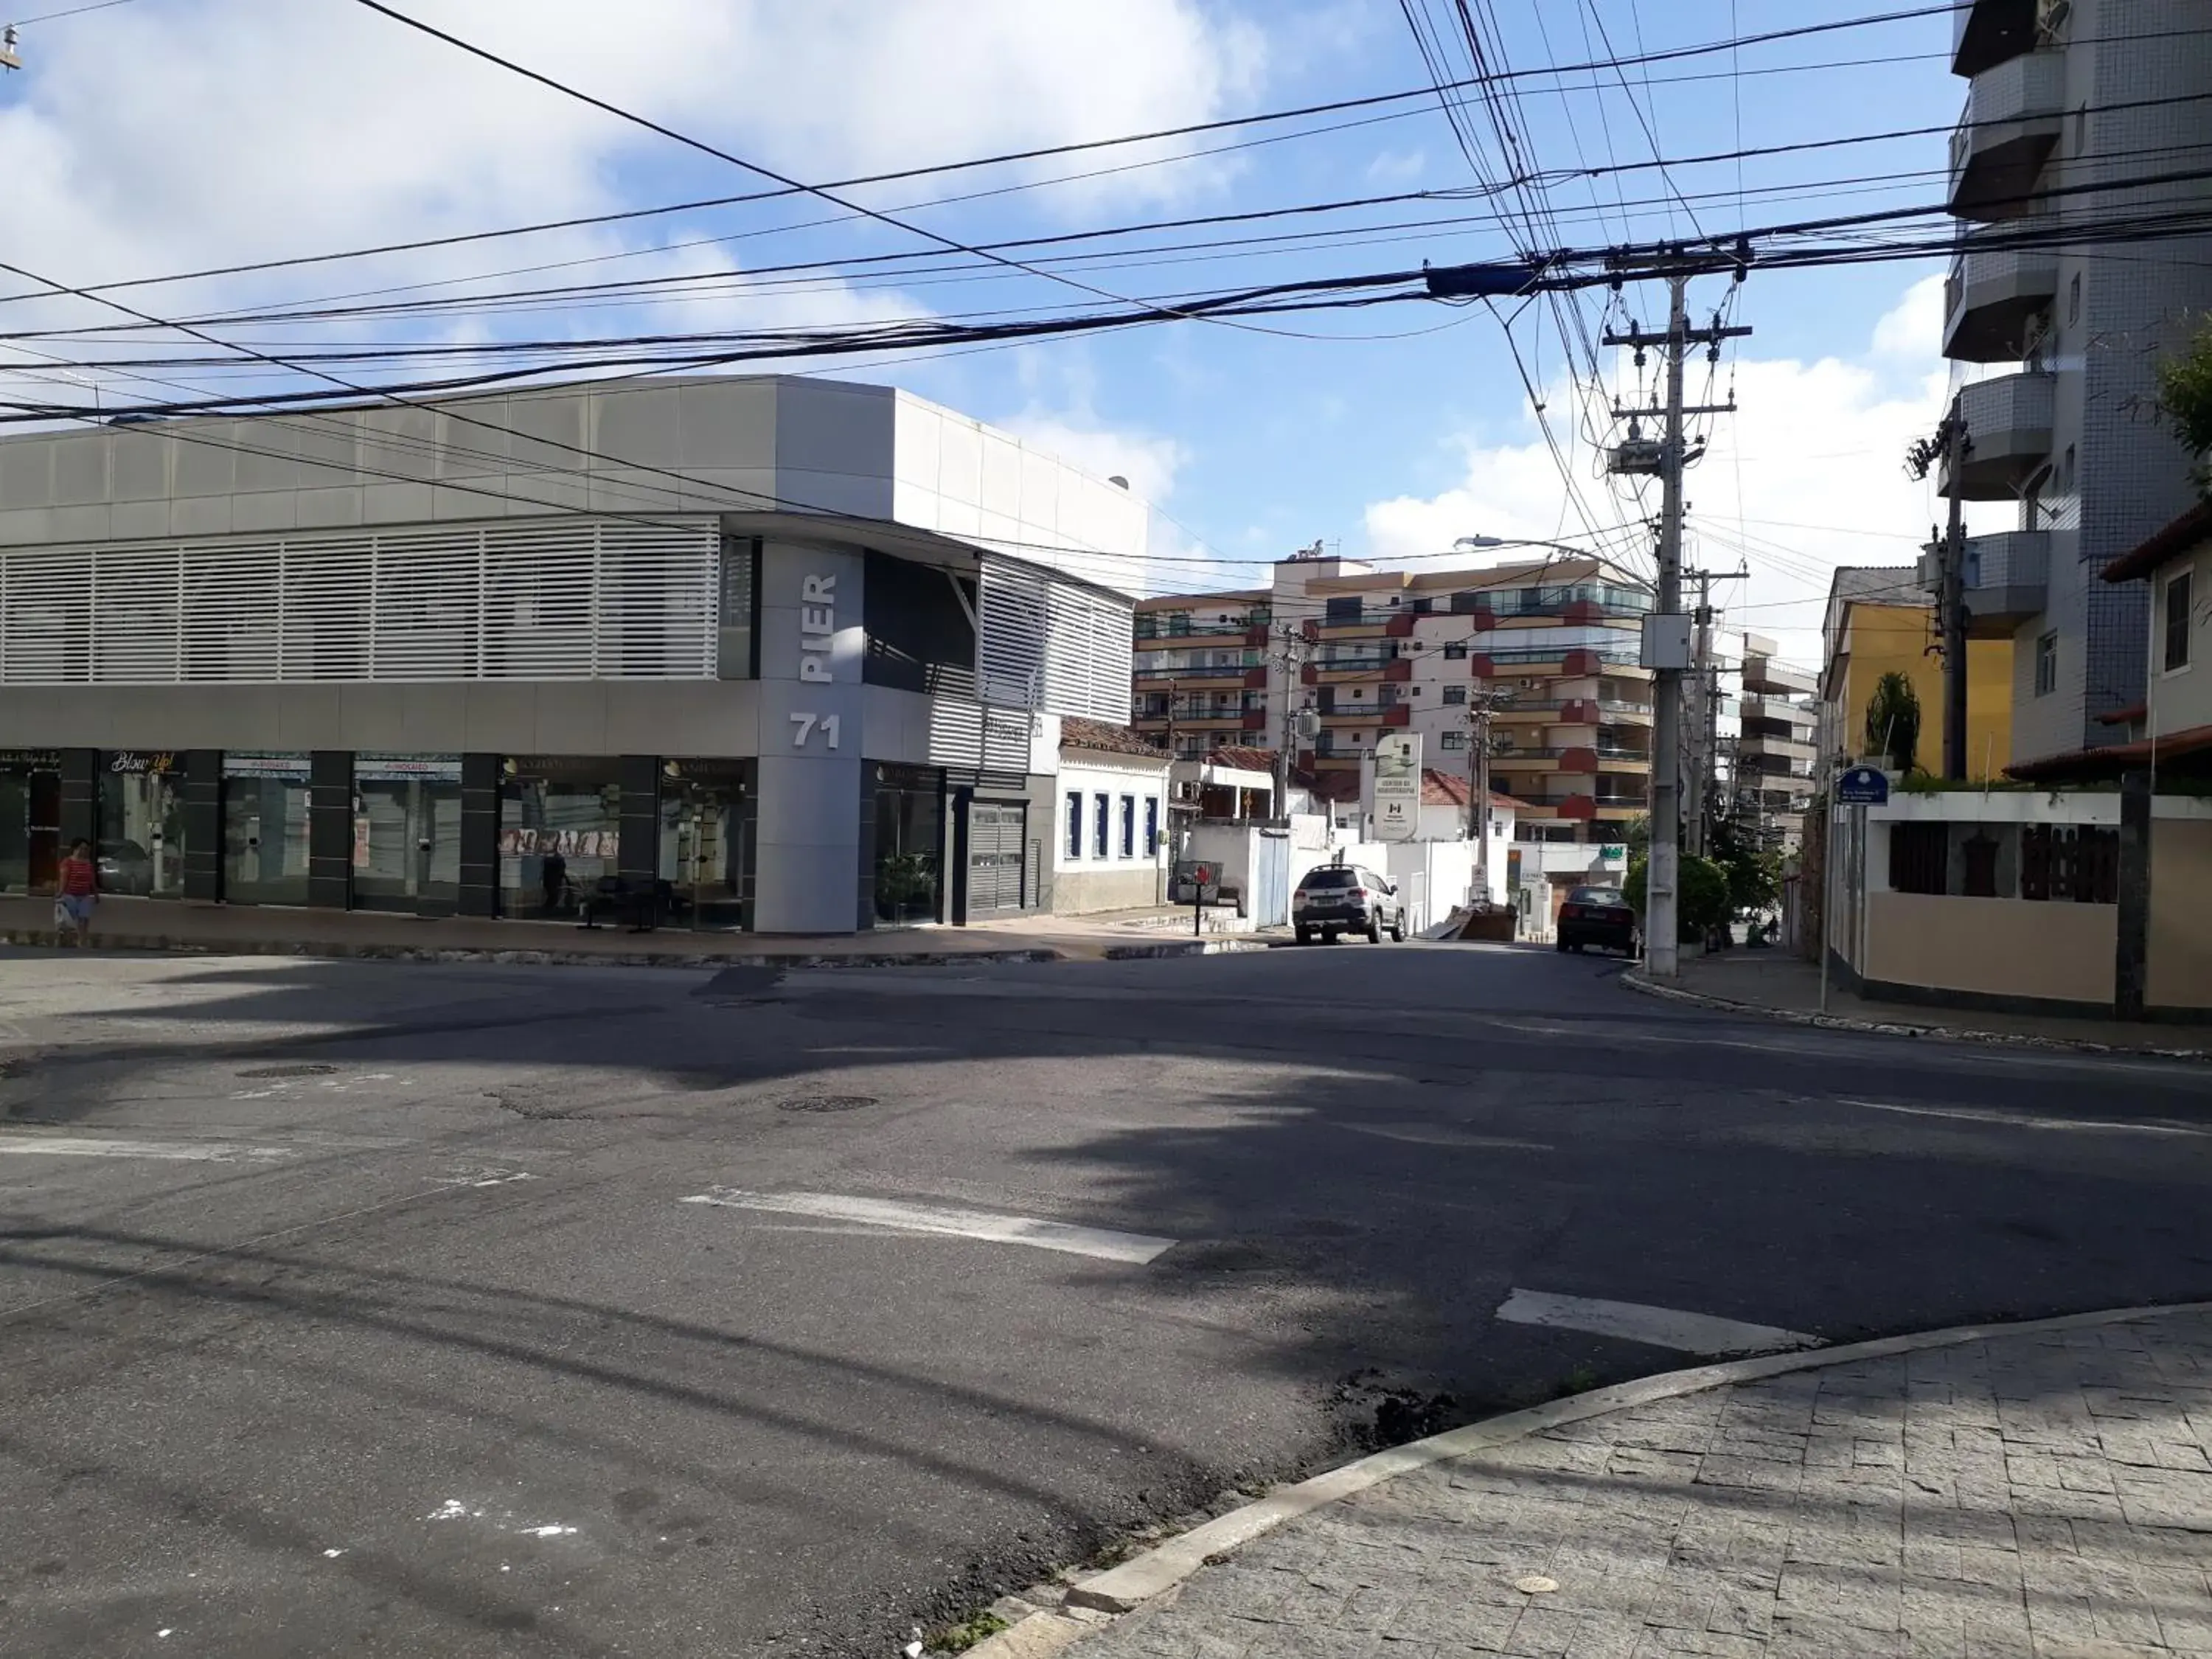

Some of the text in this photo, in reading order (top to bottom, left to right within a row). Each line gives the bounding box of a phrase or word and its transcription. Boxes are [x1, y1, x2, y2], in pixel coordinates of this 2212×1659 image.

[801, 574, 836, 683] PIER
[790, 712, 840, 750] 71
[111, 751, 150, 772] Blow
